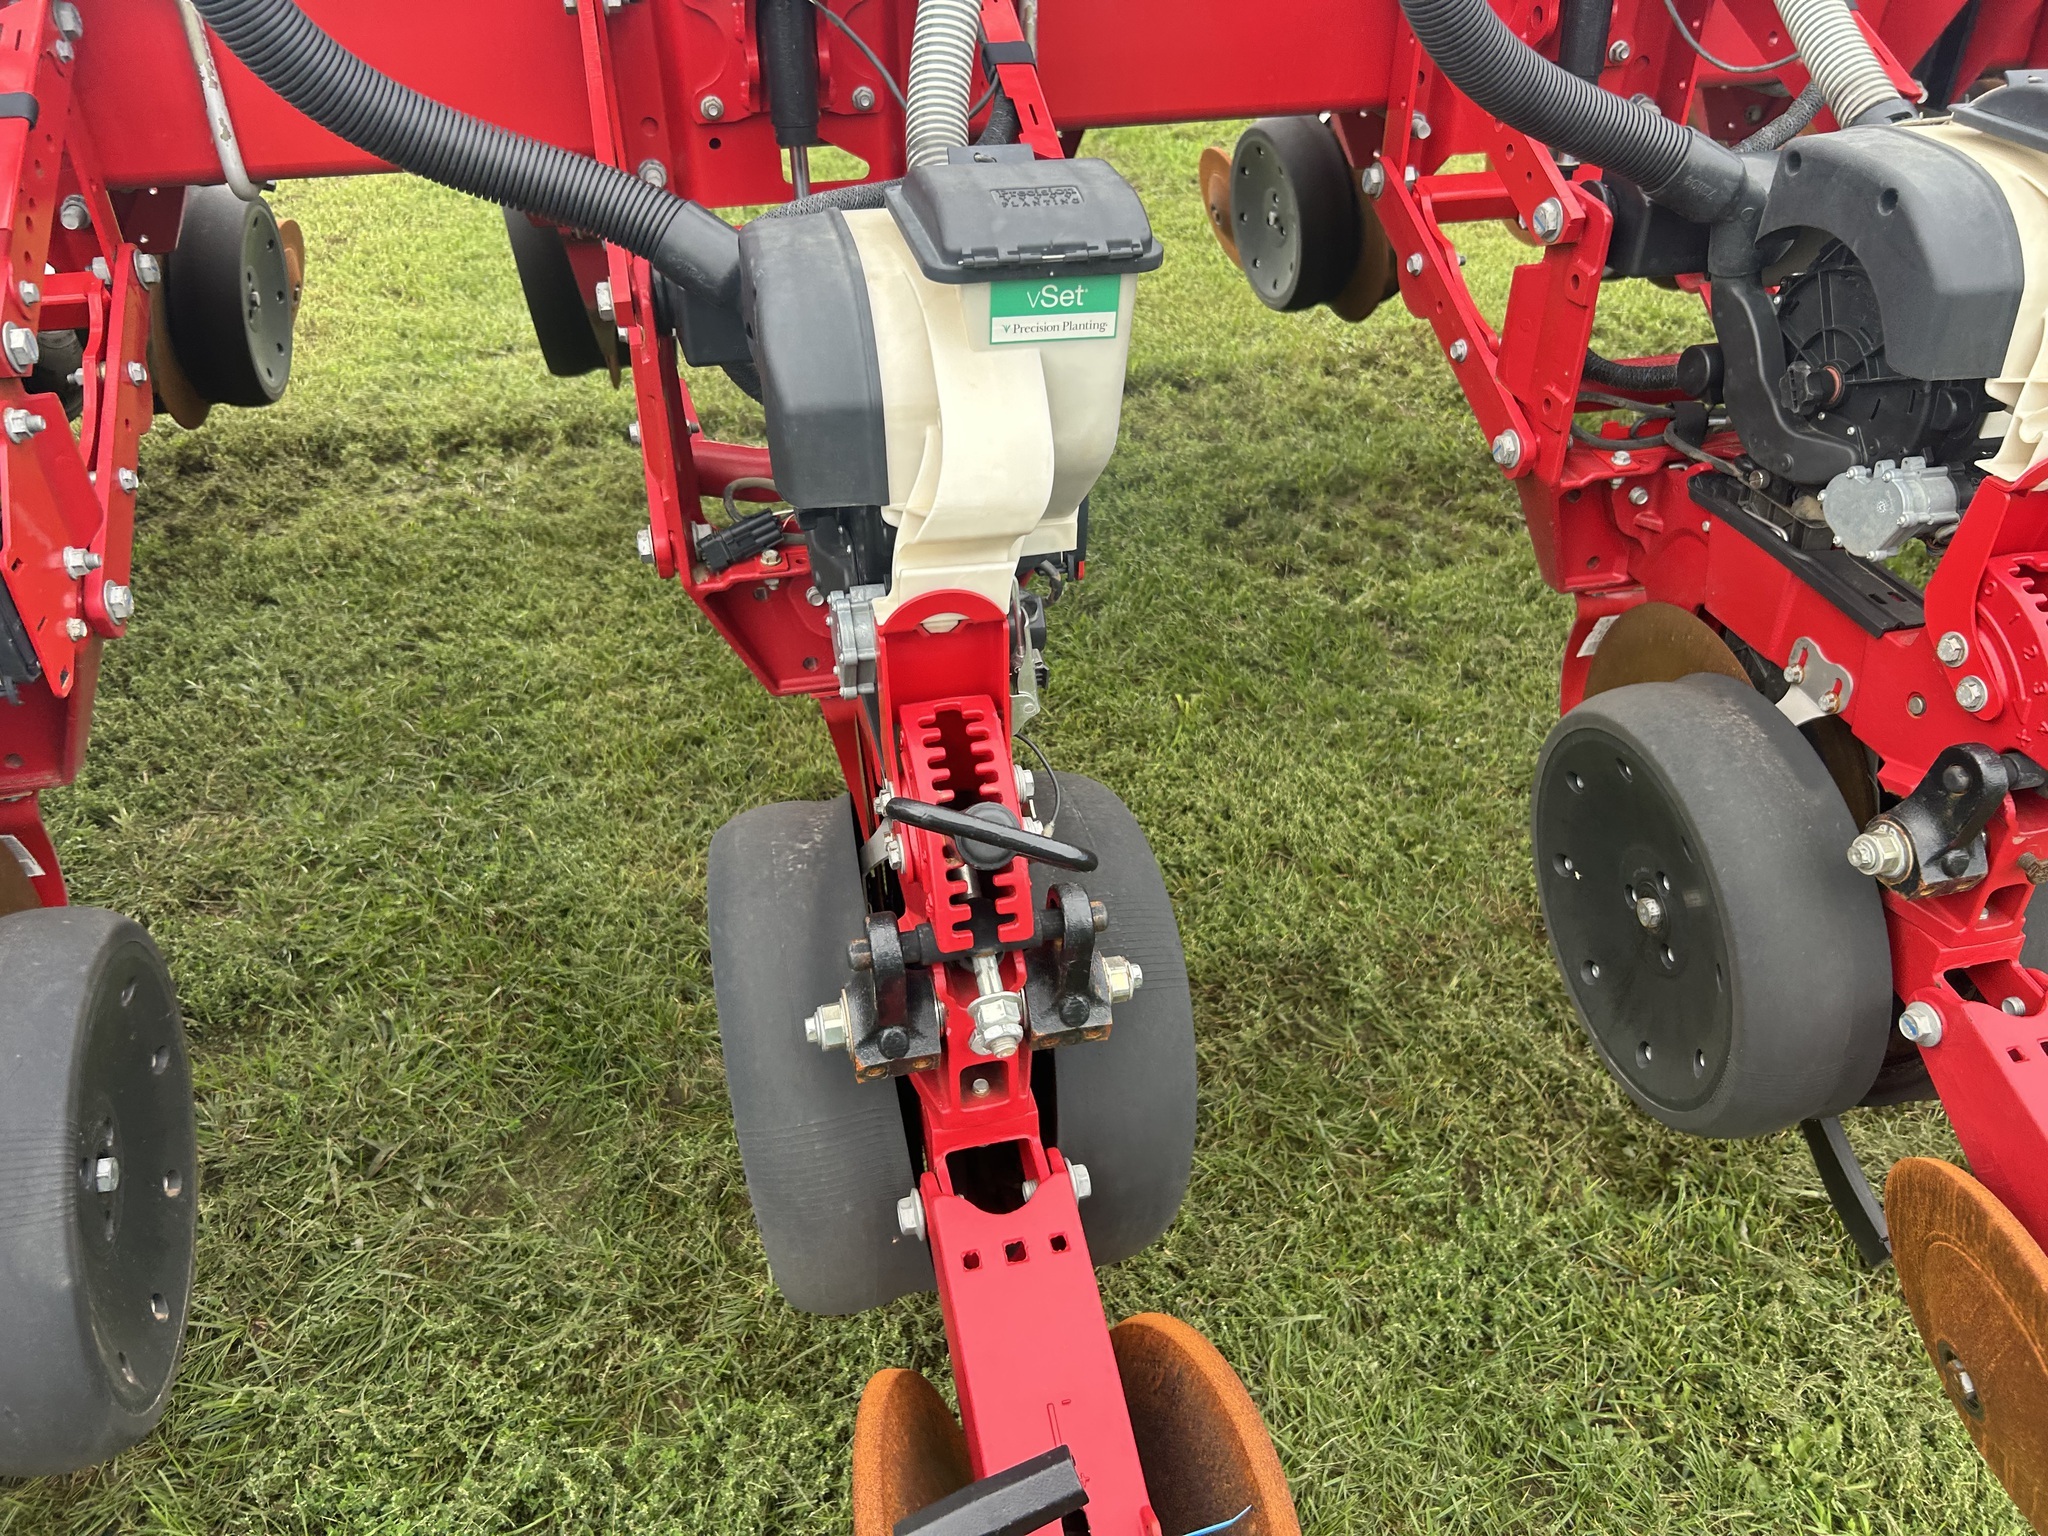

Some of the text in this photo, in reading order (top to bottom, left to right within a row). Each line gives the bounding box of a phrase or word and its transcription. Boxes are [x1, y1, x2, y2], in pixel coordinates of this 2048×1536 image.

[1002, 198, 1080, 208] PLANTING
[1026, 284, 1084, 309] vSet
[1013, 320, 1107, 334] Precision Planting
